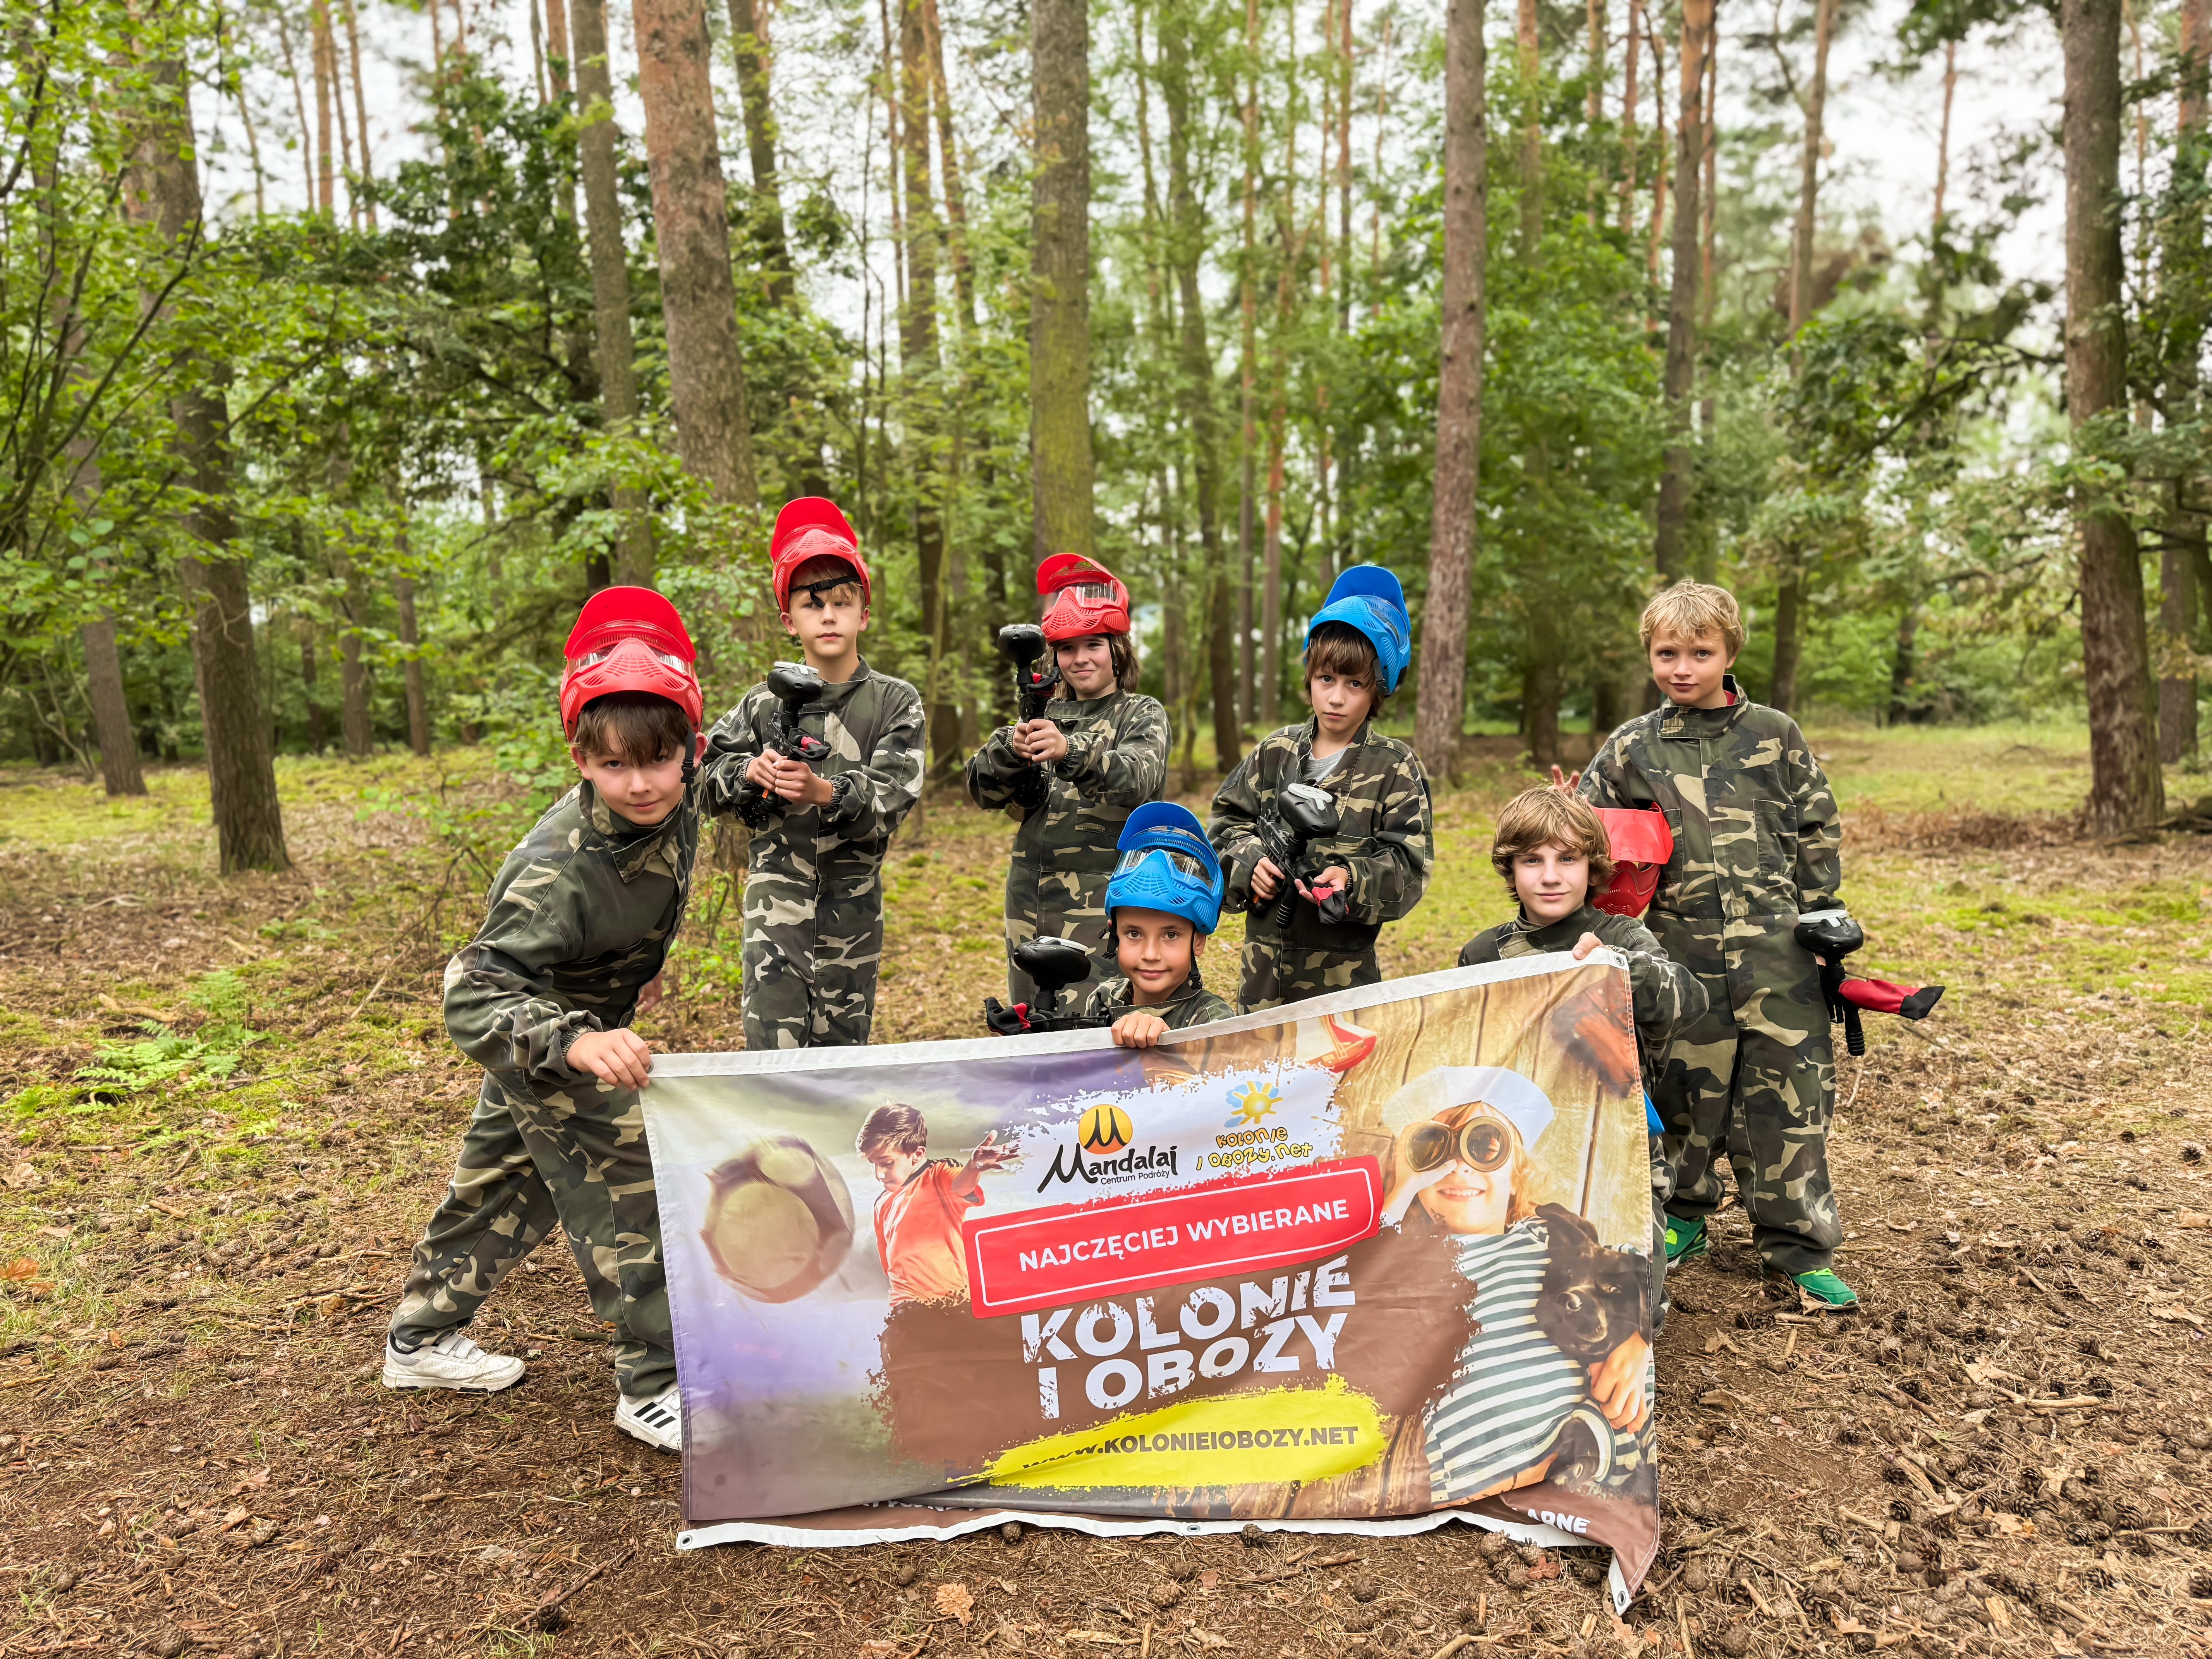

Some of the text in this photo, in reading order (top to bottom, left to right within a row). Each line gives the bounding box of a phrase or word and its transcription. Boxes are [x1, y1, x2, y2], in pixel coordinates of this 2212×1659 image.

[1037, 1142, 1178, 1193] Mandalaj
[1101, 1169, 1170, 1185] Centrum Podróży
[1019, 1199, 1349, 1271] NAJCZĘCIEJ WYBIERANE
[1021, 1254, 1355, 1364] KOLONIE
[1038, 1313, 1348, 1419] I OBOZY
[1023, 1426, 1358, 1468] .KOLONIEIOBOZY.NET
